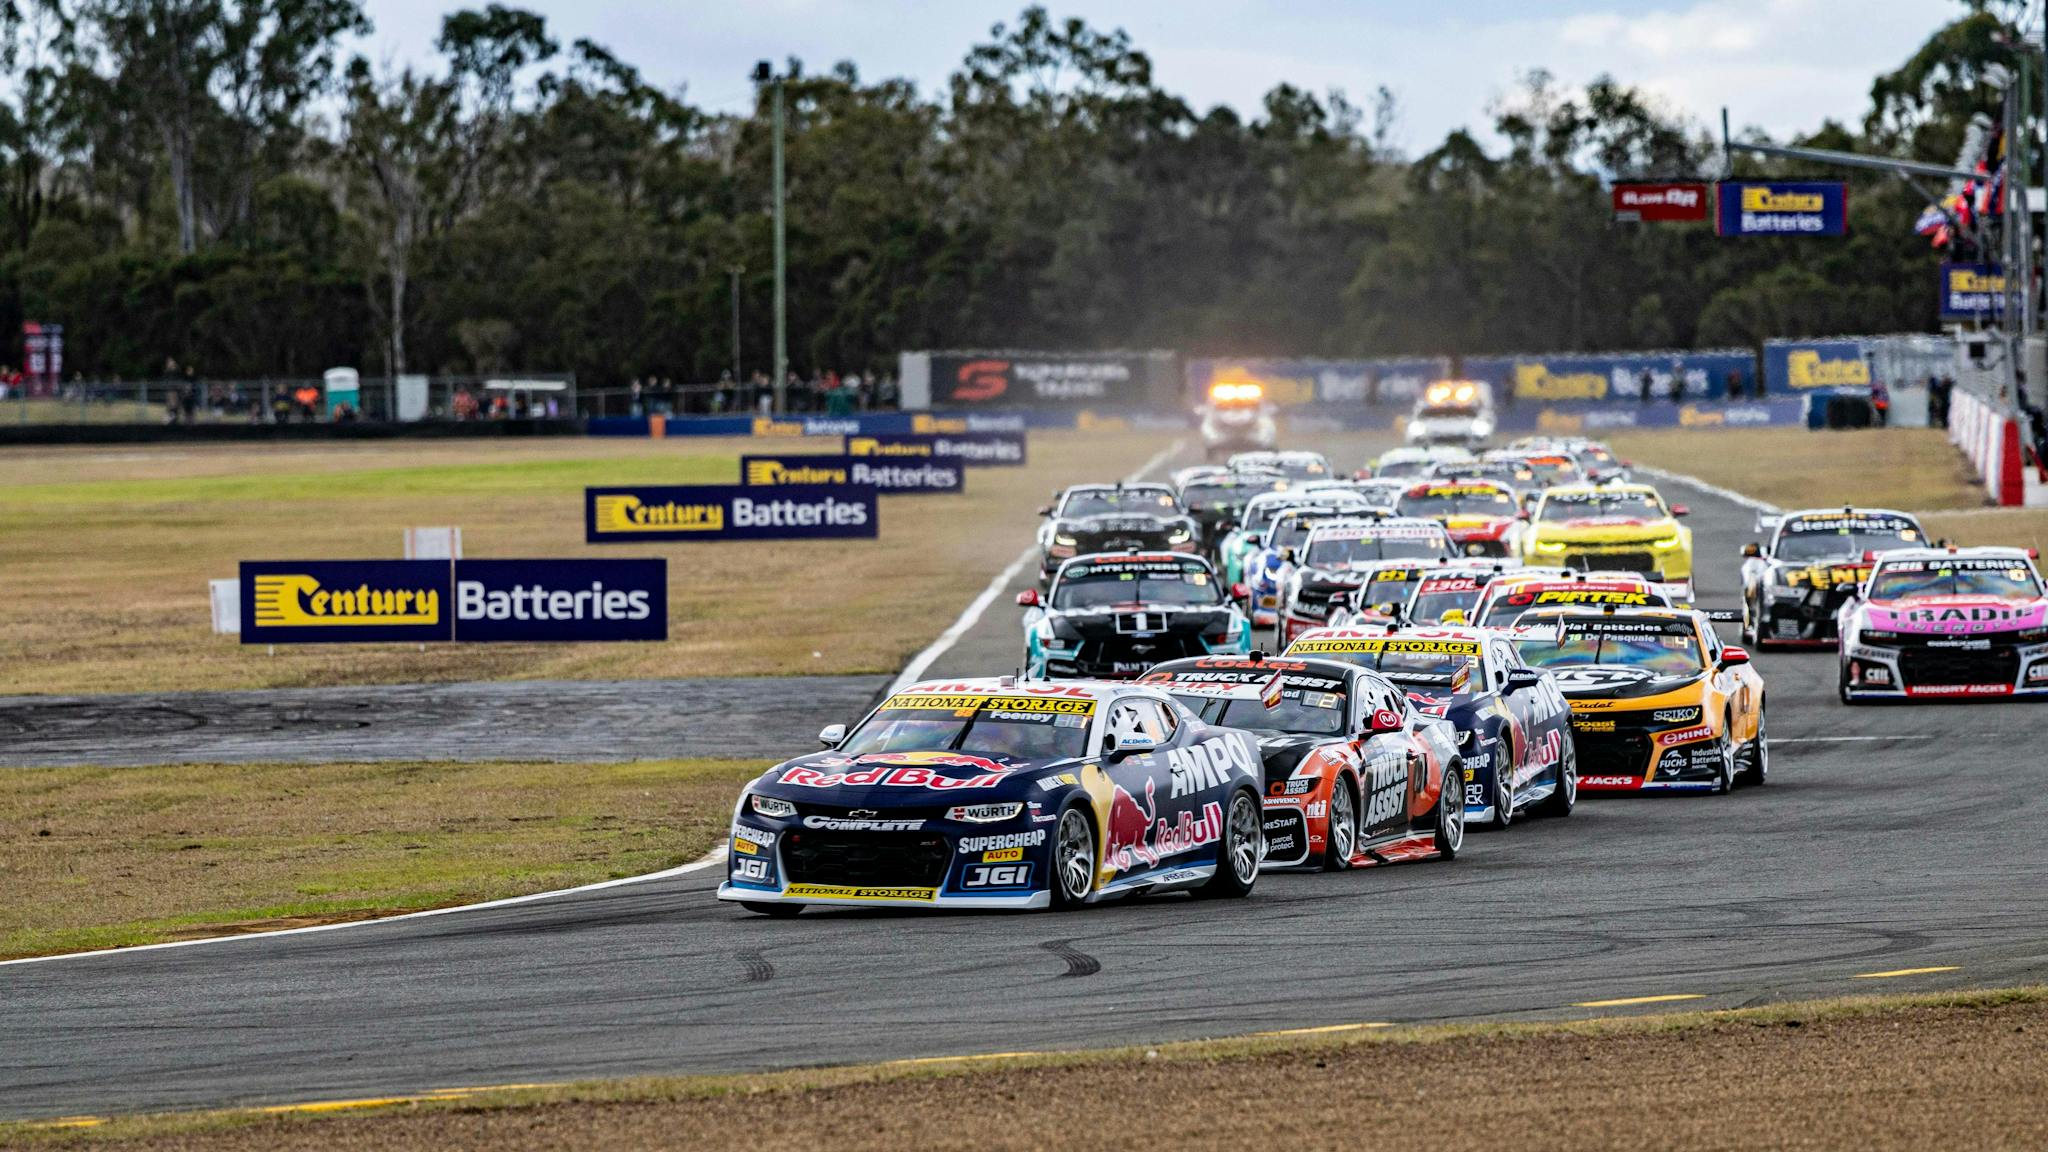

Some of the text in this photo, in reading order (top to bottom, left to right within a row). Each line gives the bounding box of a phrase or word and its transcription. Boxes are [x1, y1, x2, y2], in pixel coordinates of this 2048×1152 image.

[747, 459, 957, 488] Century Batteries
[595, 494, 868, 533] Century Batteries
[1929, 561, 2026, 571] BATTERIES
[254, 574, 651, 627] Century Batteries
[1536, 591, 1651, 606] PIRTEK
[1519, 623, 1663, 633] Indusrial Batteries
[1584, 633, 1601, 641] De
[1293, 642, 1475, 654] NATIONAL STORAGE
[1194, 658, 1309, 672] Coates
[1174, 672, 1342, 690] TRUCK ASIST
[887, 697, 1091, 713] NATIONAL STORAGE
[1569, 701, 1616, 709] Cadet
[990, 710, 1054, 724] Feeney
[1167, 733, 1260, 800] AMPOL
[1659, 758, 1688, 769] FUCHS
[1691, 757, 1721, 765] Batteries
[777, 766, 887, 788] Red
[882, 768, 1012, 791] Bull
[1371, 752, 1408, 792] TRUCK
[1285, 779, 1310, 788] TRUCK
[1284, 787, 1309, 795] ASSIST
[1264, 797, 1301, 805] ARWRENCH
[1306, 799, 1327, 816] nti
[1365, 780, 1408, 828] ASSIST
[967, 806, 1016, 818] WÜRTH
[802, 815, 927, 831] COMPLETE
[1183, 800, 1223, 850] Bull
[1263, 817, 1298, 830] RESTAFF
[958, 829, 1046, 854] SUPERCHEAP
[1271, 833, 1293, 846] parcel
[735, 841, 756, 853] AUTO
[1270, 841, 1295, 853] protect
[986, 850, 1019, 861] AUTO
[733, 857, 769, 880] JGI
[966, 865, 1029, 887] JGI
[787, 886, 931, 899] NATIONAL STORAGE
